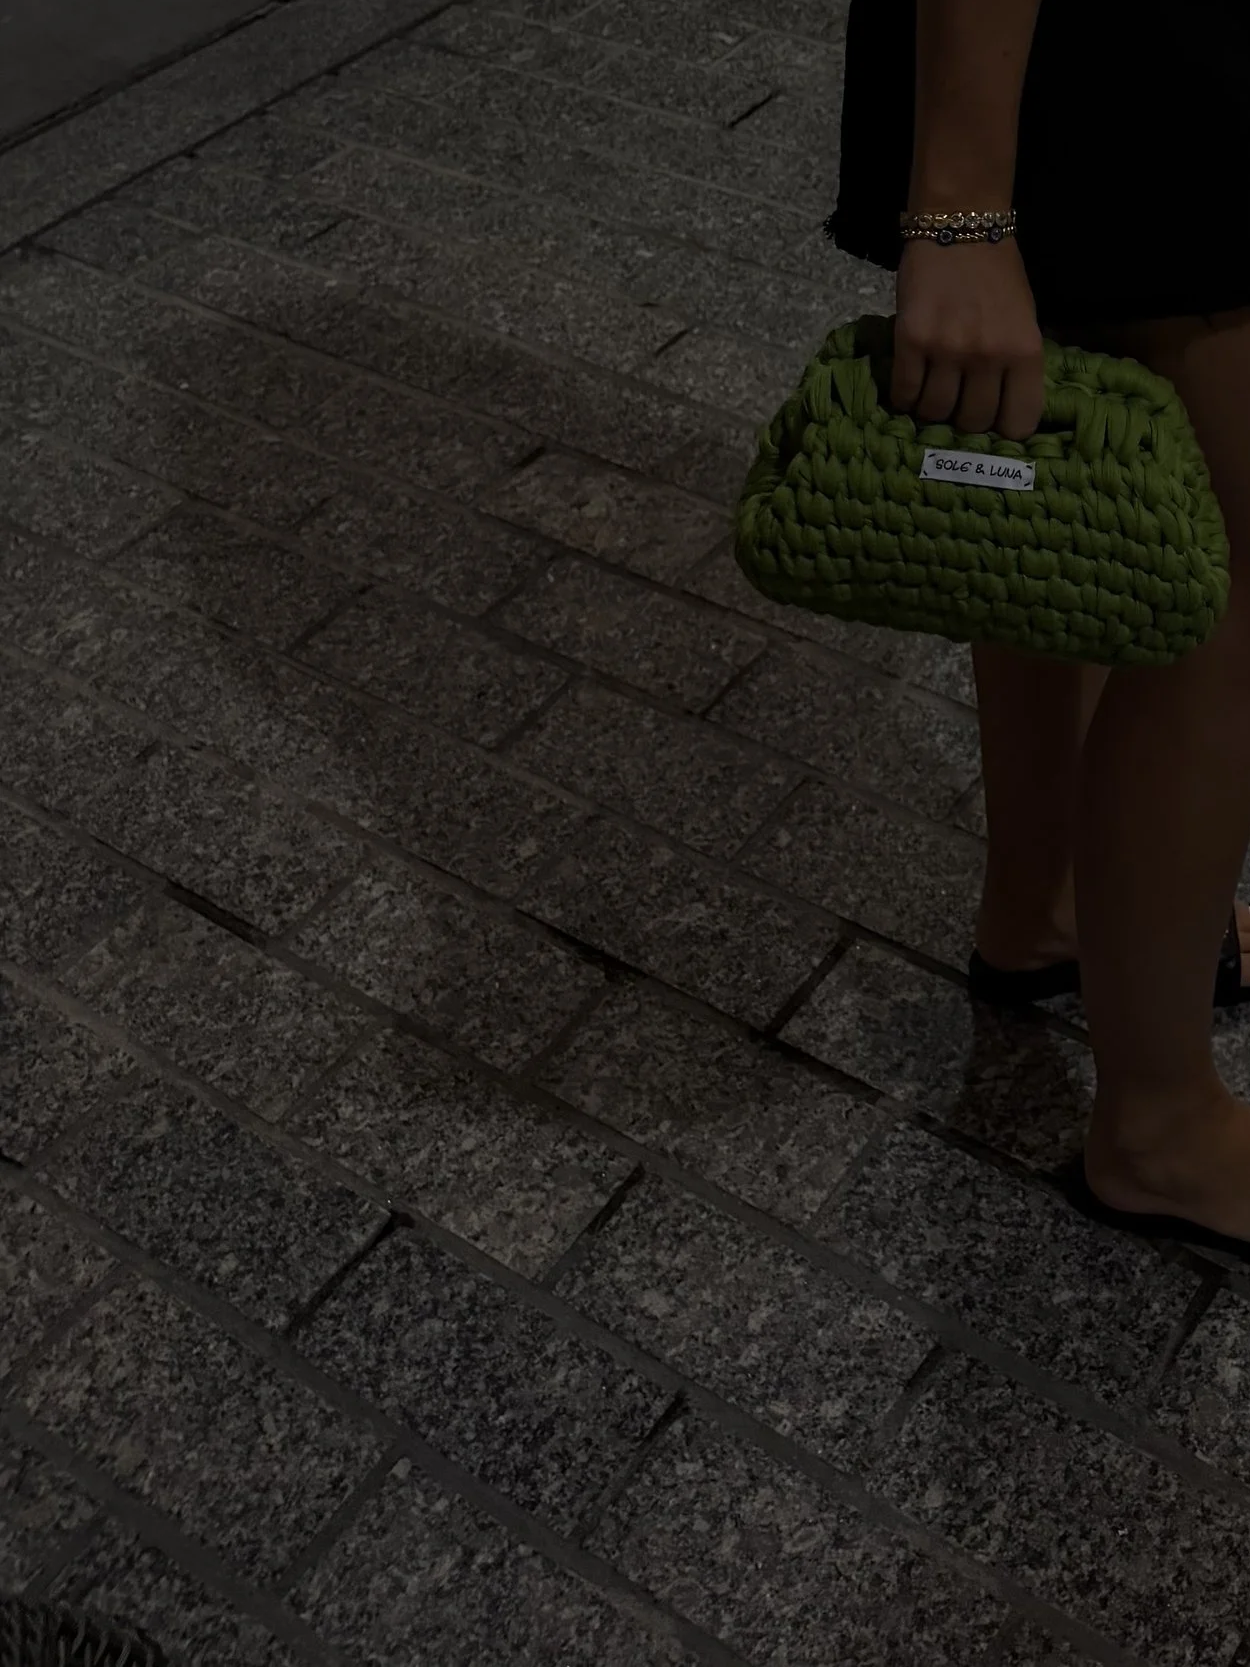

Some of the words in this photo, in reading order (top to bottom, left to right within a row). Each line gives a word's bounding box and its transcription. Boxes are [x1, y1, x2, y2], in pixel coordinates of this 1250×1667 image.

[935, 459, 972, 472] SOLE
[975, 464, 985, 475] &
[990, 465, 1022, 479] LUNA
